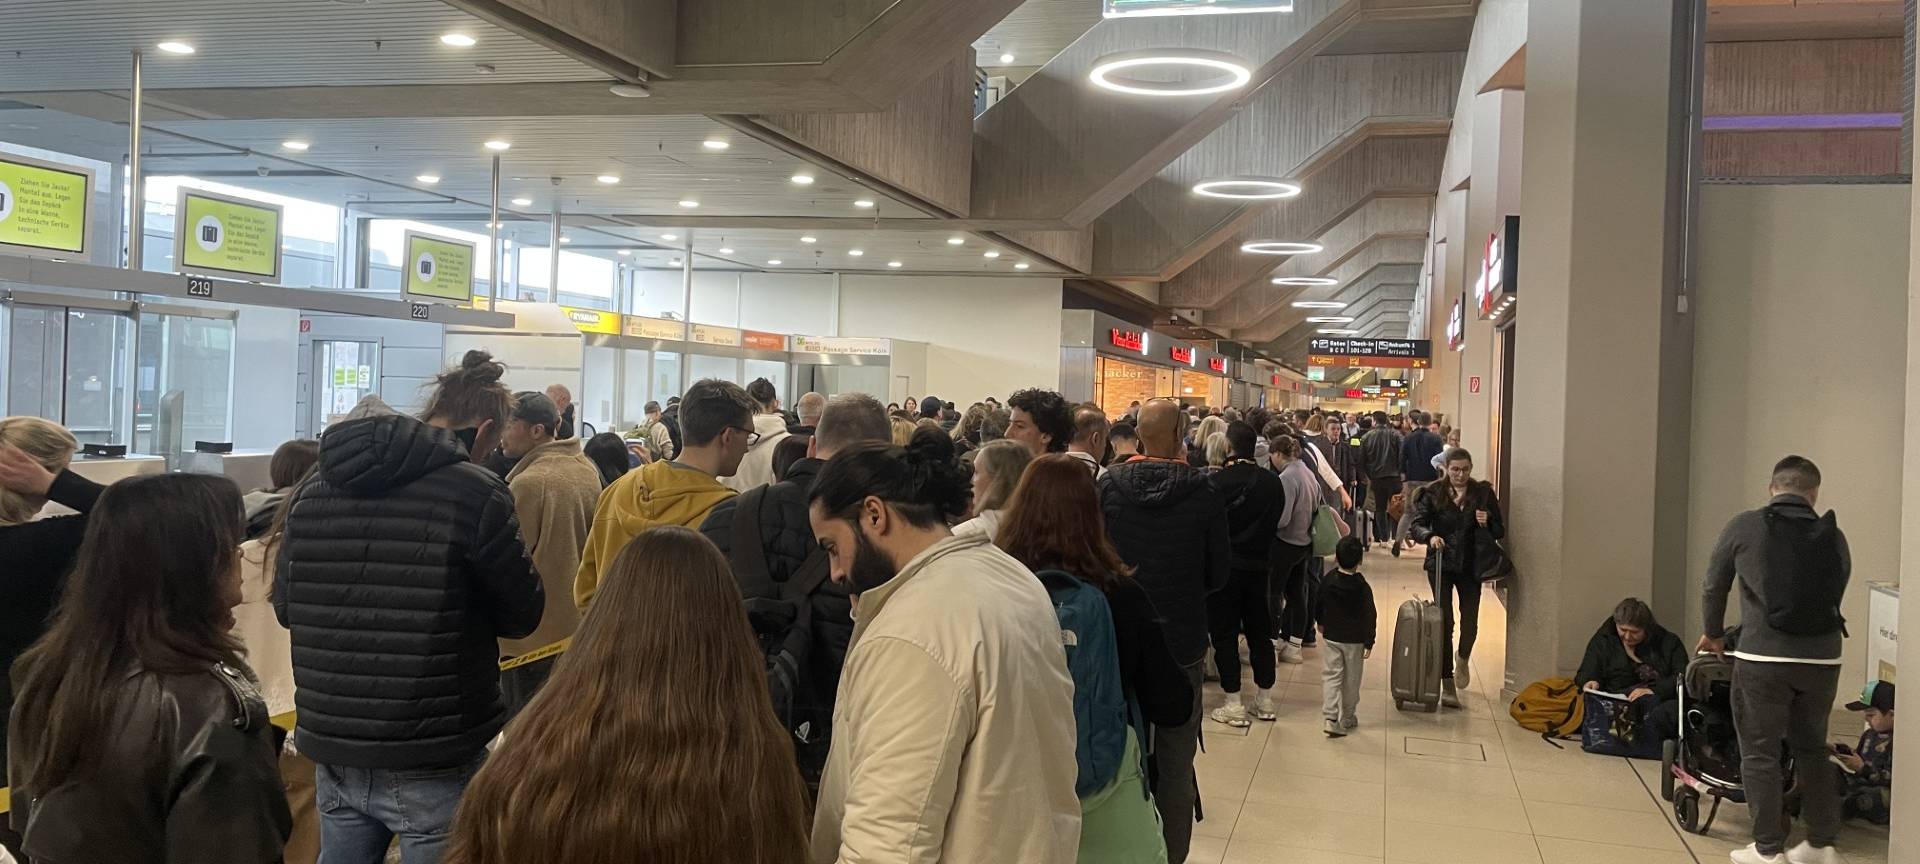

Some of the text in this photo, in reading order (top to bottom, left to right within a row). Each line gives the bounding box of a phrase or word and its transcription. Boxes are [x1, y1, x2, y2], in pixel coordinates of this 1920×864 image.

[19, 187, 40, 196] Mantel
[190, 280, 210, 295] 219
[412, 305, 428, 317] 220
[1388, 341, 1410, 349] Ankunft
